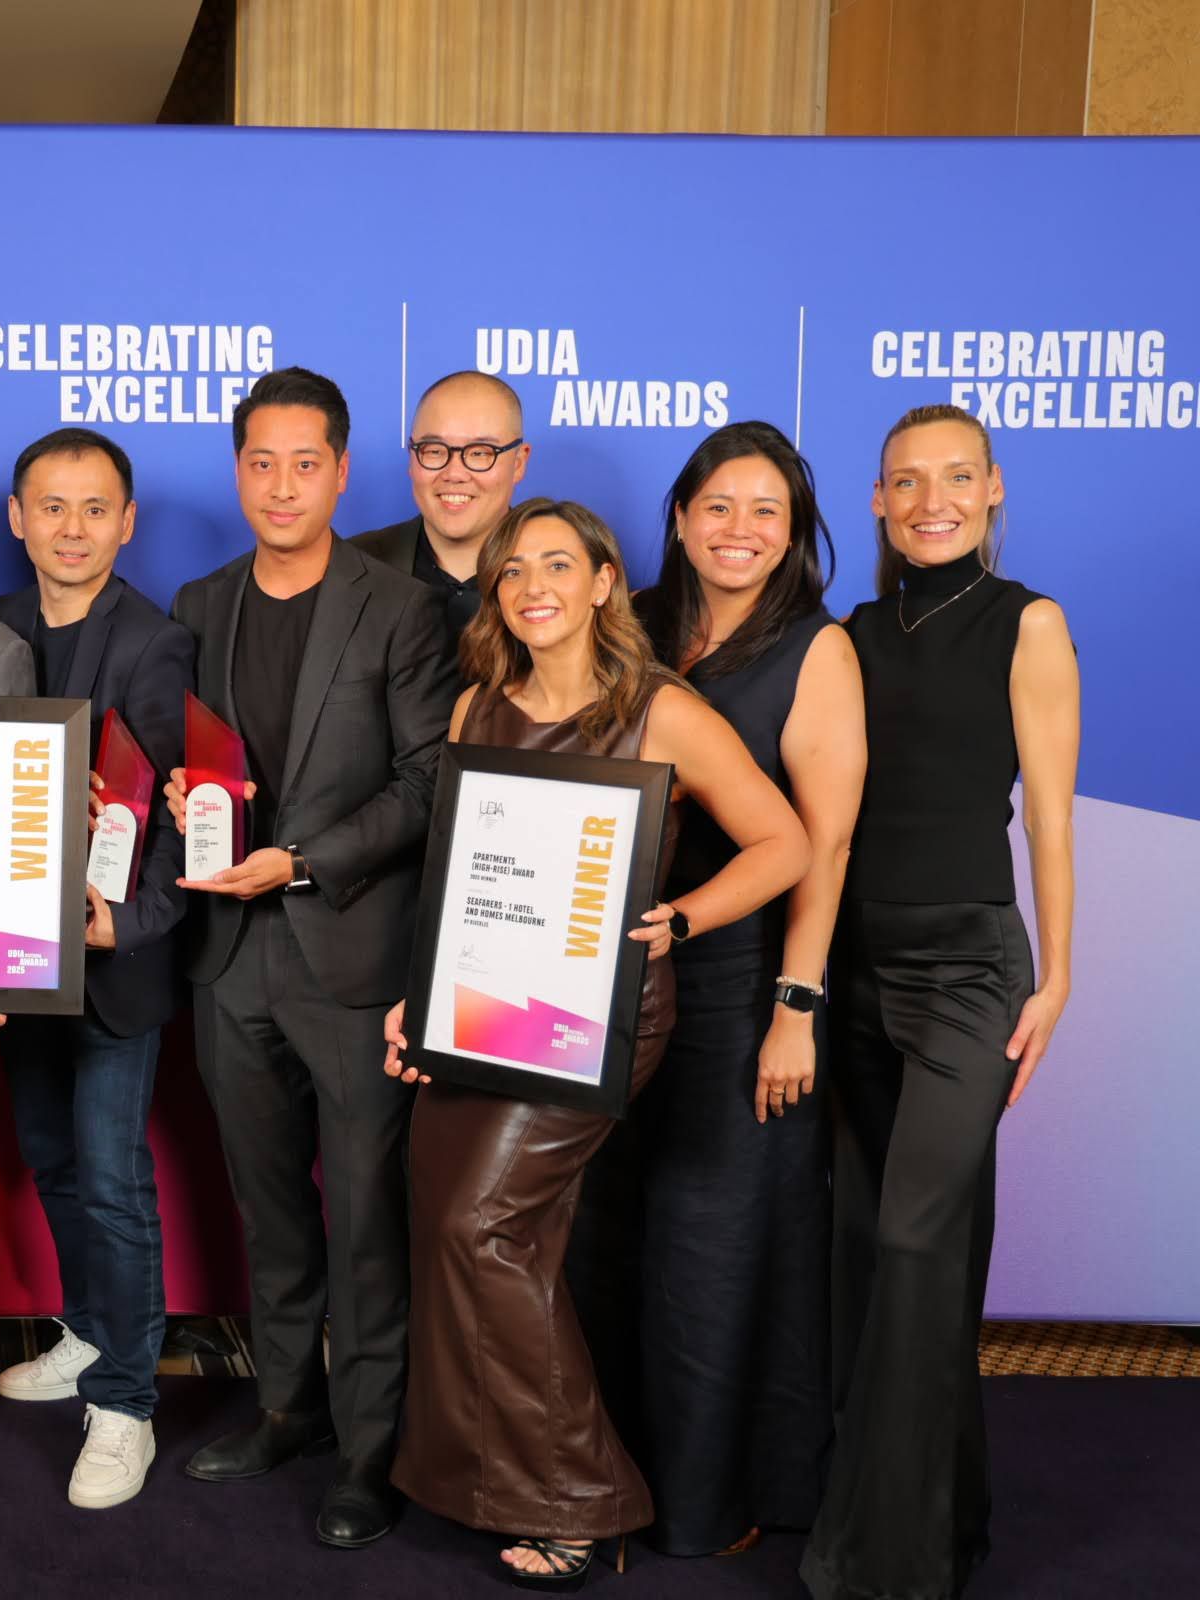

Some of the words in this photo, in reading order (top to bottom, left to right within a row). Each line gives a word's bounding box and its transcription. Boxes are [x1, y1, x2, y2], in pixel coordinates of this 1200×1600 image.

[476, 328, 579, 375] UDIA
[871, 330, 1165, 377] CELEBRATING
[60, 376, 258, 423] EXCELLE
[550, 380, 729, 428] AWARDS
[951, 381, 1200, 429] EXCELLENC
[10, 739, 50, 881] WINNER
[472, 861, 511, 875] (HIGH-RISE)
[512, 867, 535, 878] AWARD
[473, 852, 516, 865] APARTMENTS
[466, 896, 503, 909] SEAFARERS
[514, 904, 534, 914] HOTEL
[565, 815, 617, 958] WINNER
[465, 907, 479, 916] AND
[480, 909, 503, 920] HOMES
[505, 913, 546, 927] MELBOURNE
